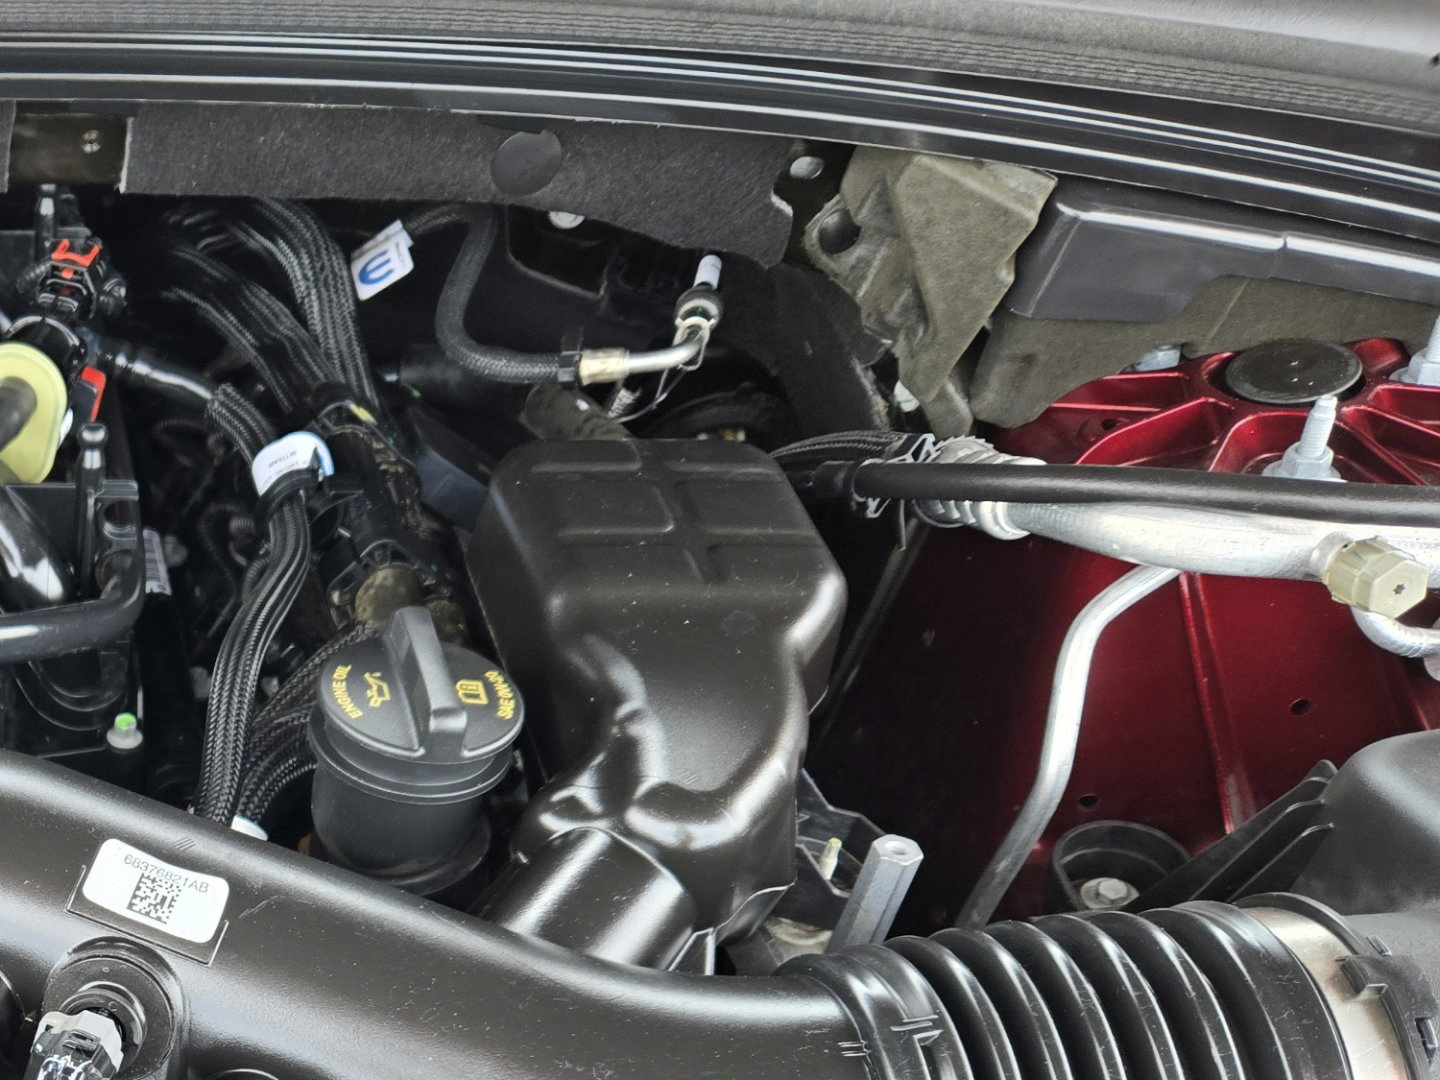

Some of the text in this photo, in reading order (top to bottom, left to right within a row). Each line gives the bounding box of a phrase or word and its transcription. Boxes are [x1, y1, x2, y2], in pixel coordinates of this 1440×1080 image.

[333, 664, 363, 719] ENGINE OIL
[497, 698, 515, 719] SAE
[124, 854, 210, 894] 68376821AB
